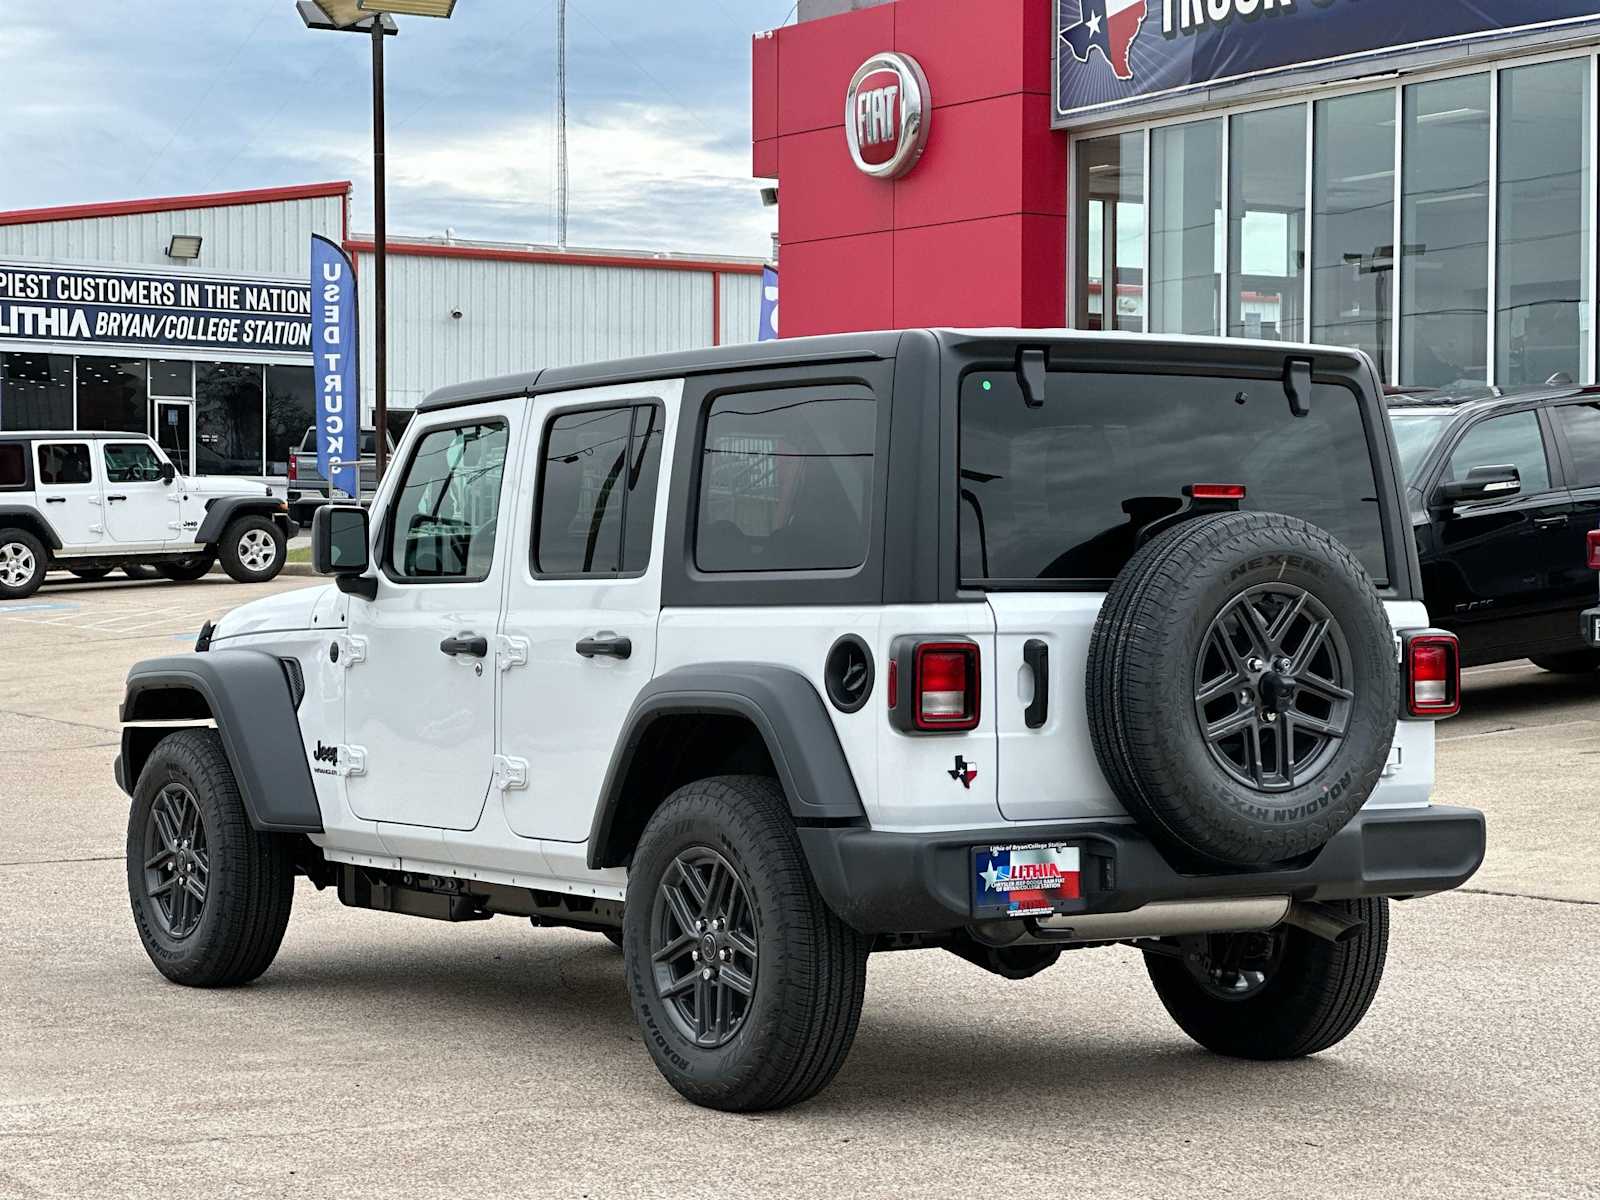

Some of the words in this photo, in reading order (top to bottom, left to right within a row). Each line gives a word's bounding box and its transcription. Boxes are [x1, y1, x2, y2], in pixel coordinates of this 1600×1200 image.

[857, 85, 898, 148] FIAT
[56, 276, 175, 306] CUSTOMERS
[180, 282, 200, 307] IN
[204, 284, 241, 310] THE
[245, 286, 311, 314] NATION
[0, 304, 92, 338] LITHIA
[95, 311, 241, 343] BRYAN/COLLEGE
[242, 319, 312, 346] STATION
[313, 740, 338, 767] Jeep
[1011, 863, 1061, 880] LITHIA
